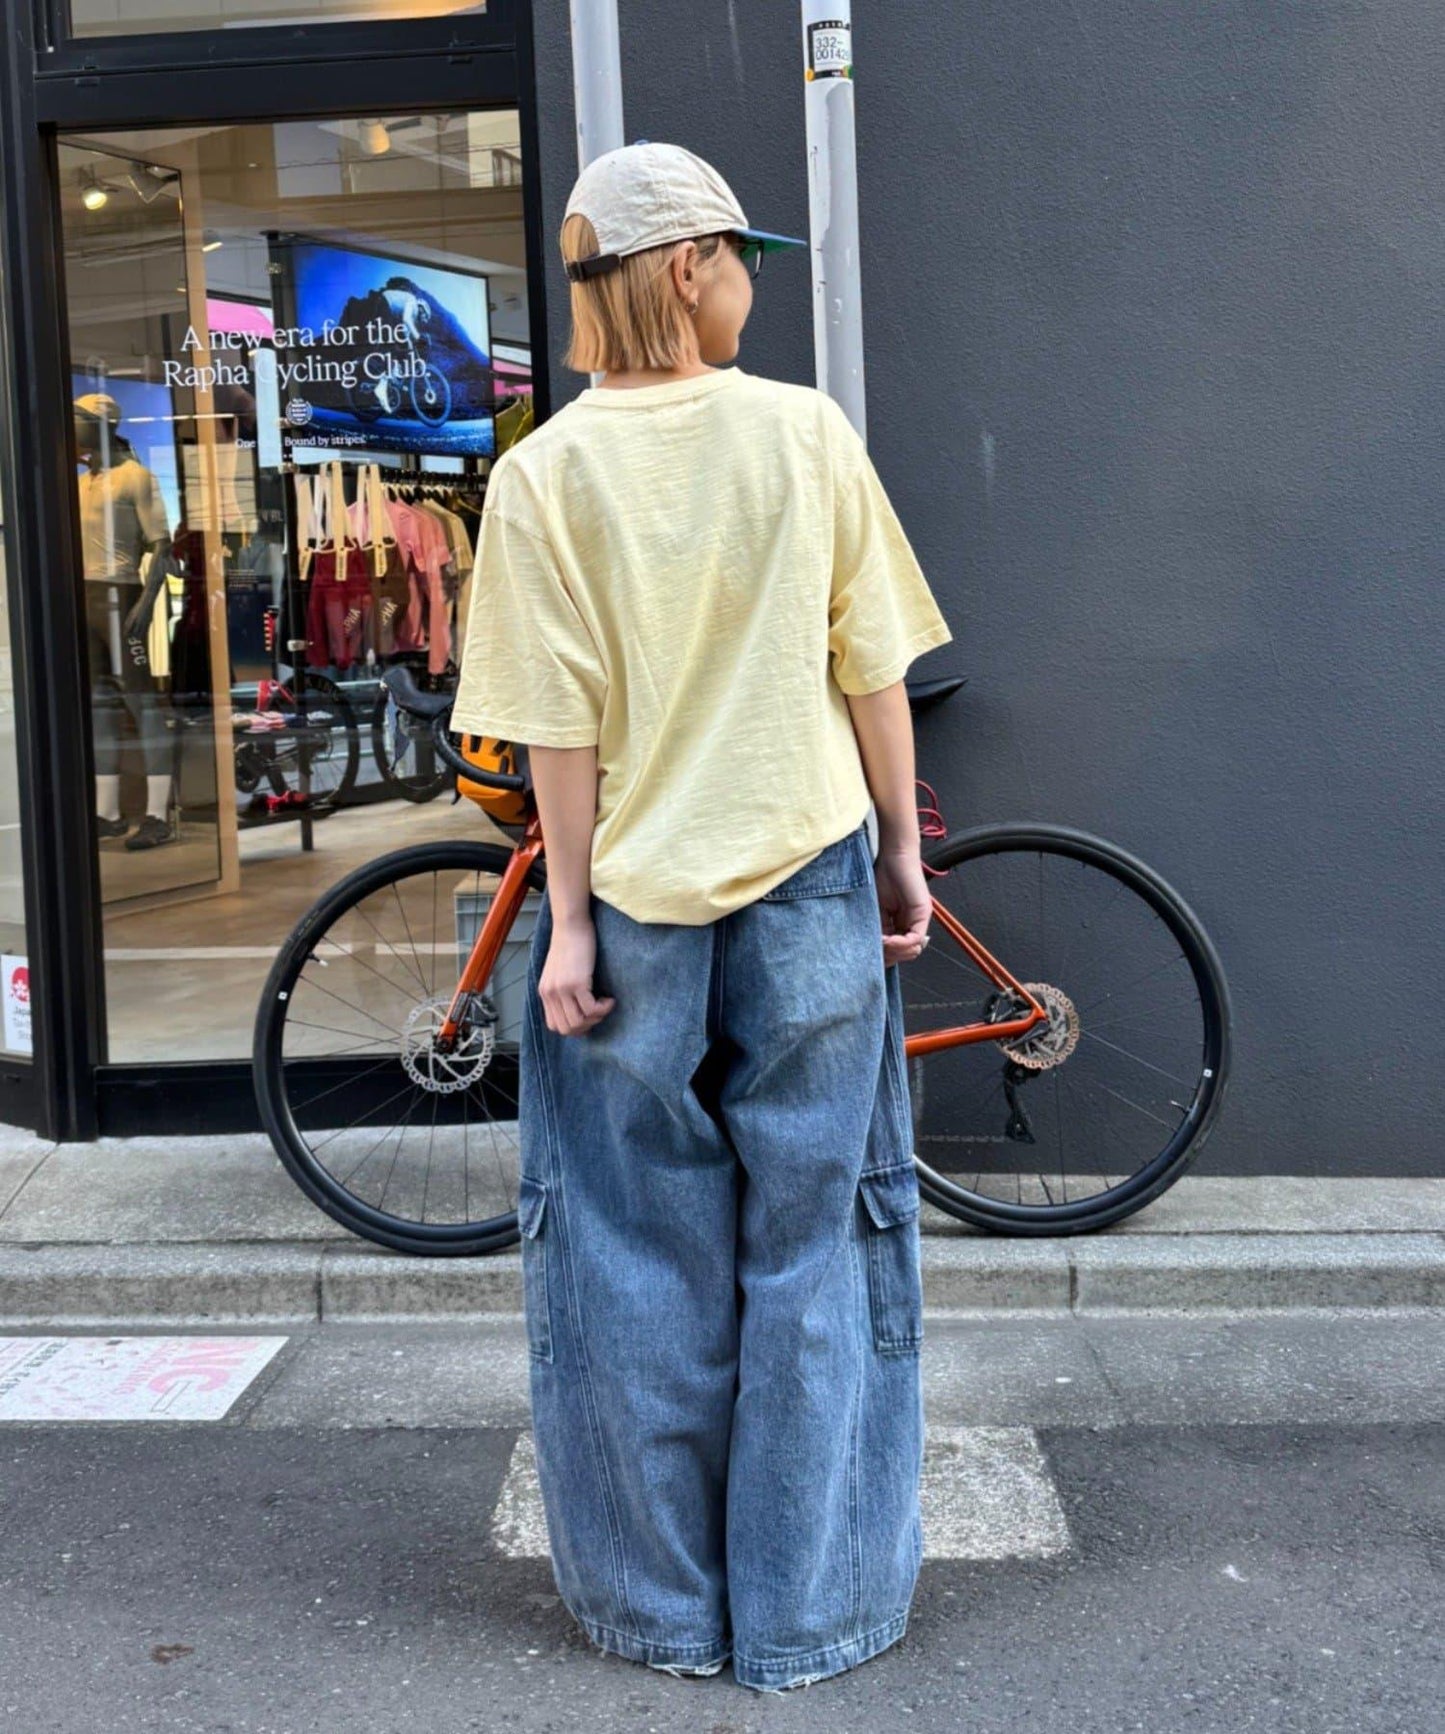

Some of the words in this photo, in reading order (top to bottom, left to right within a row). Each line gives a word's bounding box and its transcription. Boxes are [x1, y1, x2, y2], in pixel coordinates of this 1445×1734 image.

[180, 325, 204, 352] A
[209, 329, 265, 350] new
[272, 326, 315, 348] era
[322, 319, 359, 347] for
[365, 317, 409, 344] the
[162, 359, 250, 393] Rapha
[256, 354, 358, 390] Cycling
[363, 351, 431, 379] Club.
[235, 438, 256, 448] One
[284, 435, 316, 447] Bound
[317, 435, 330, 447] by
